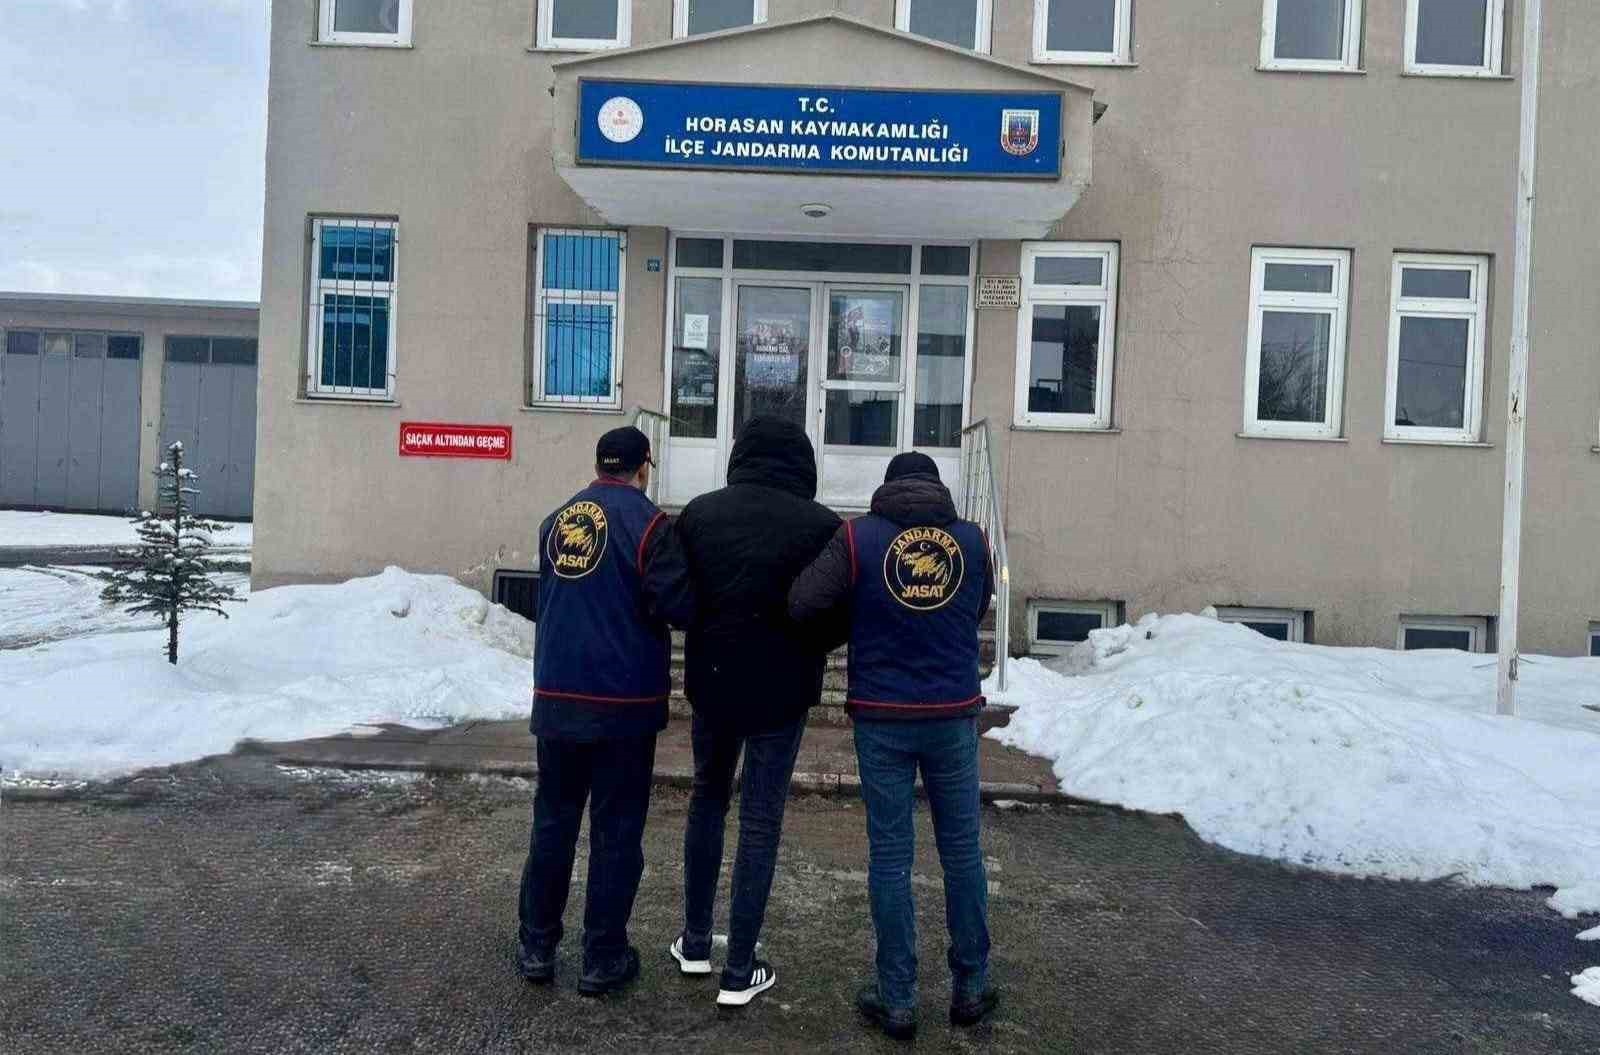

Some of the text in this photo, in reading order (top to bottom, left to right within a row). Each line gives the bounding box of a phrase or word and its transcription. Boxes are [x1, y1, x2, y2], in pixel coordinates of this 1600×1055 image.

[798, 97, 835, 113] T.C.
[686, 116, 948, 140] HORASAN KAYMAKAMLIĞI
[665, 134, 968, 163] İLÇE JANDARMA KOMUTANLIĞI
[405, 432, 505, 451] SAÇAK ALTINDAN GEÇME
[558, 504, 605, 530] JANDARMA
[893, 529, 957, 555] JANDARMA
[555, 554, 590, 569] JASAT
[902, 584, 945, 598] JASAT
